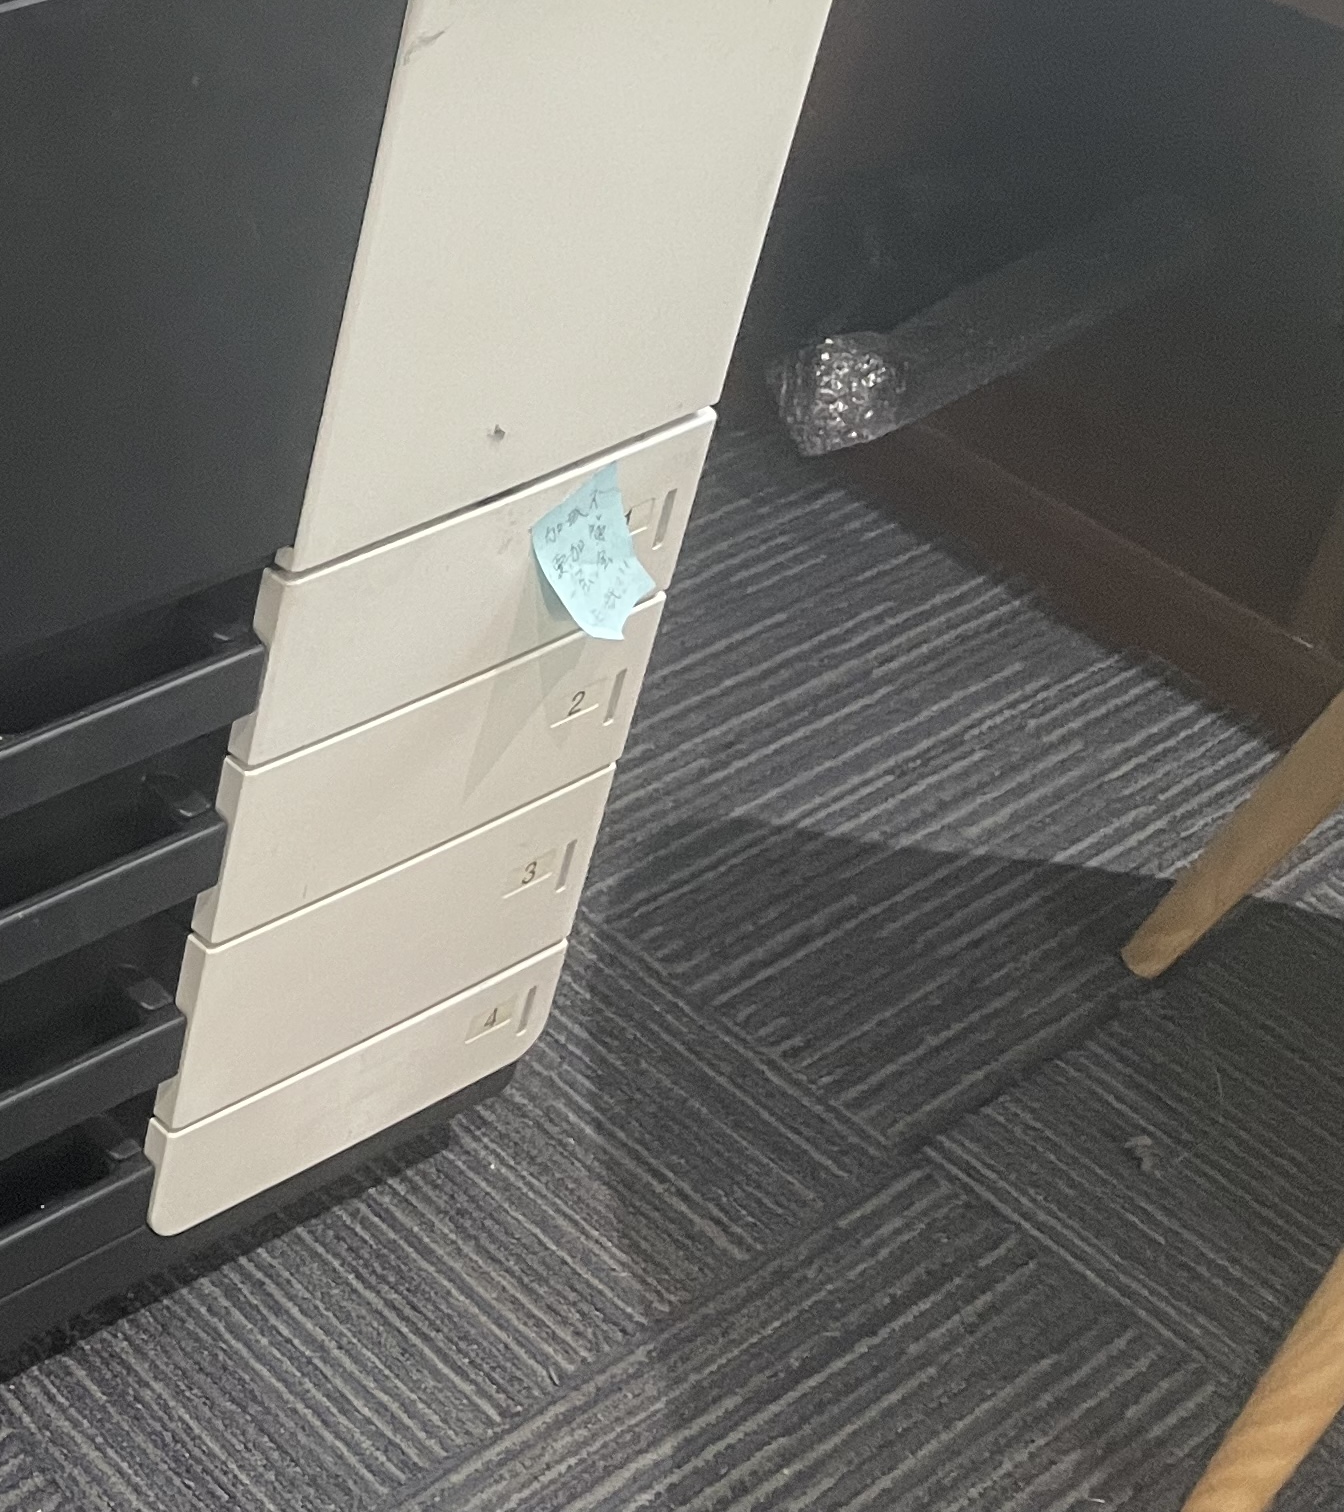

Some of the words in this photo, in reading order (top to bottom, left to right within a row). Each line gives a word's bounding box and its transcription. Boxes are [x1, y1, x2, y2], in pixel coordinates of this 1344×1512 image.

[567, 690, 586, 717] 2
[522, 860, 538, 885] 3
[483, 1007, 499, 1029] 4
